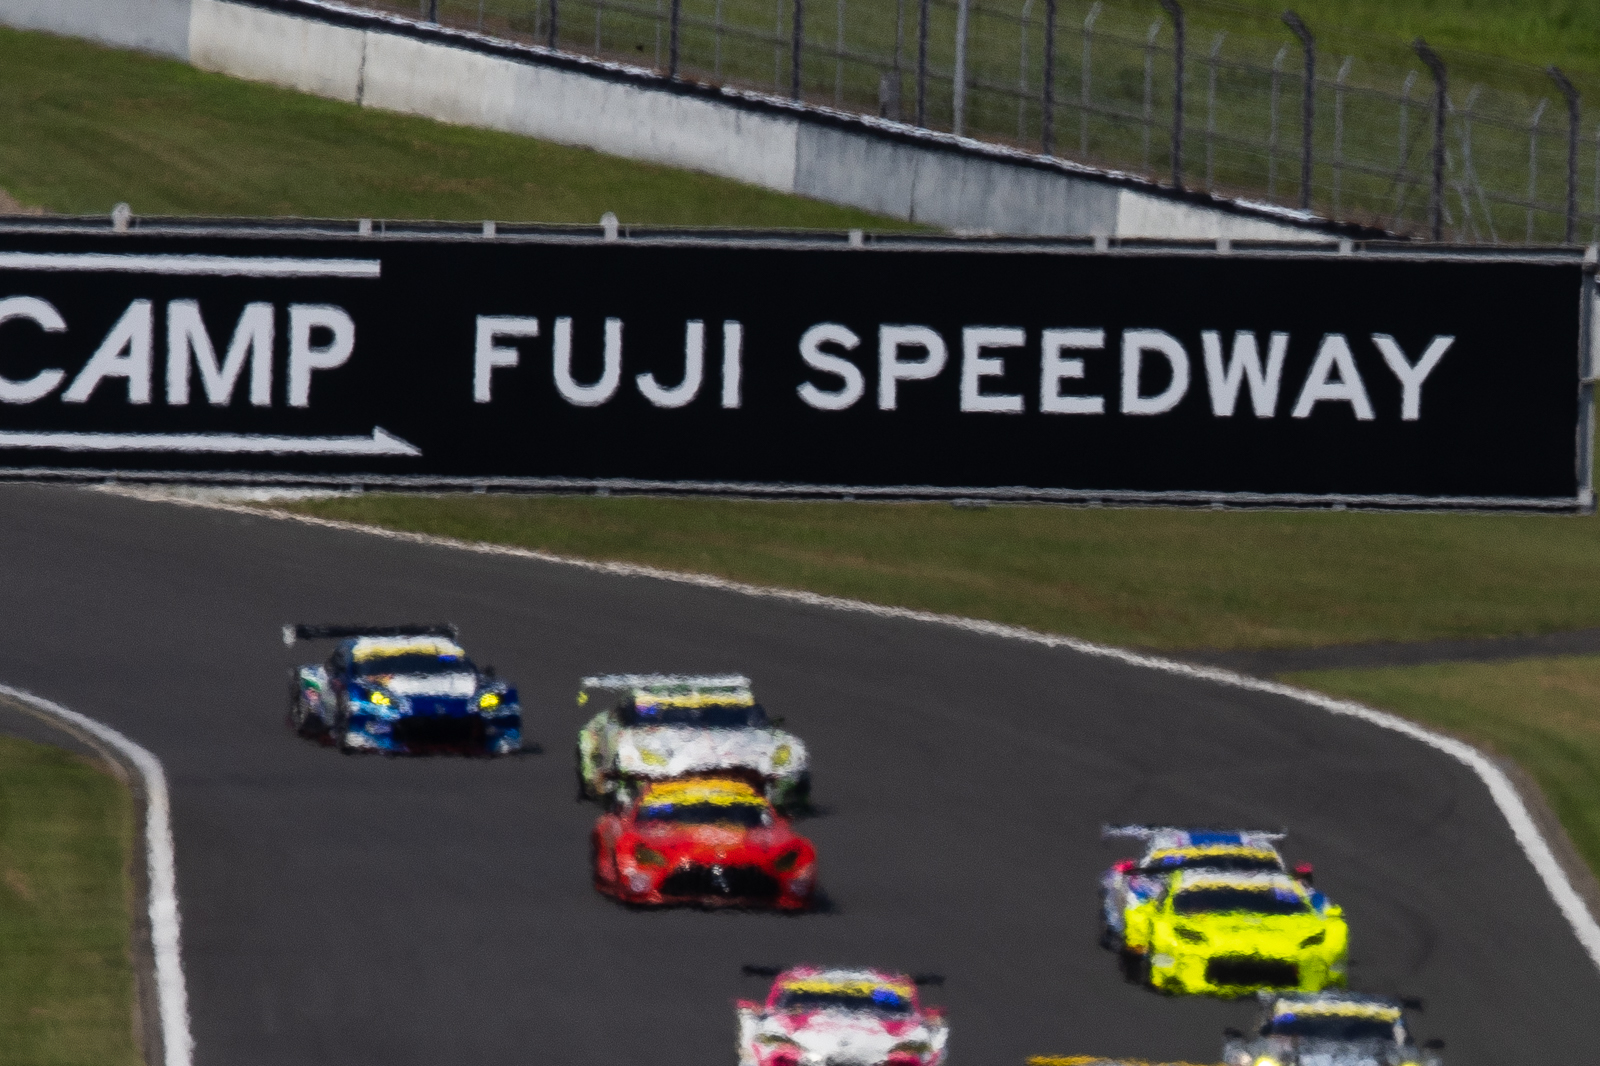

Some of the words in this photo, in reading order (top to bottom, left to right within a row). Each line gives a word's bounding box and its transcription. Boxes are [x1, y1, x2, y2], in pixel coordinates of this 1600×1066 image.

[0, 295, 356, 408] CAMP
[473, 314, 744, 409] FUJI
[796, 322, 1456, 421] SPEEDWAY
